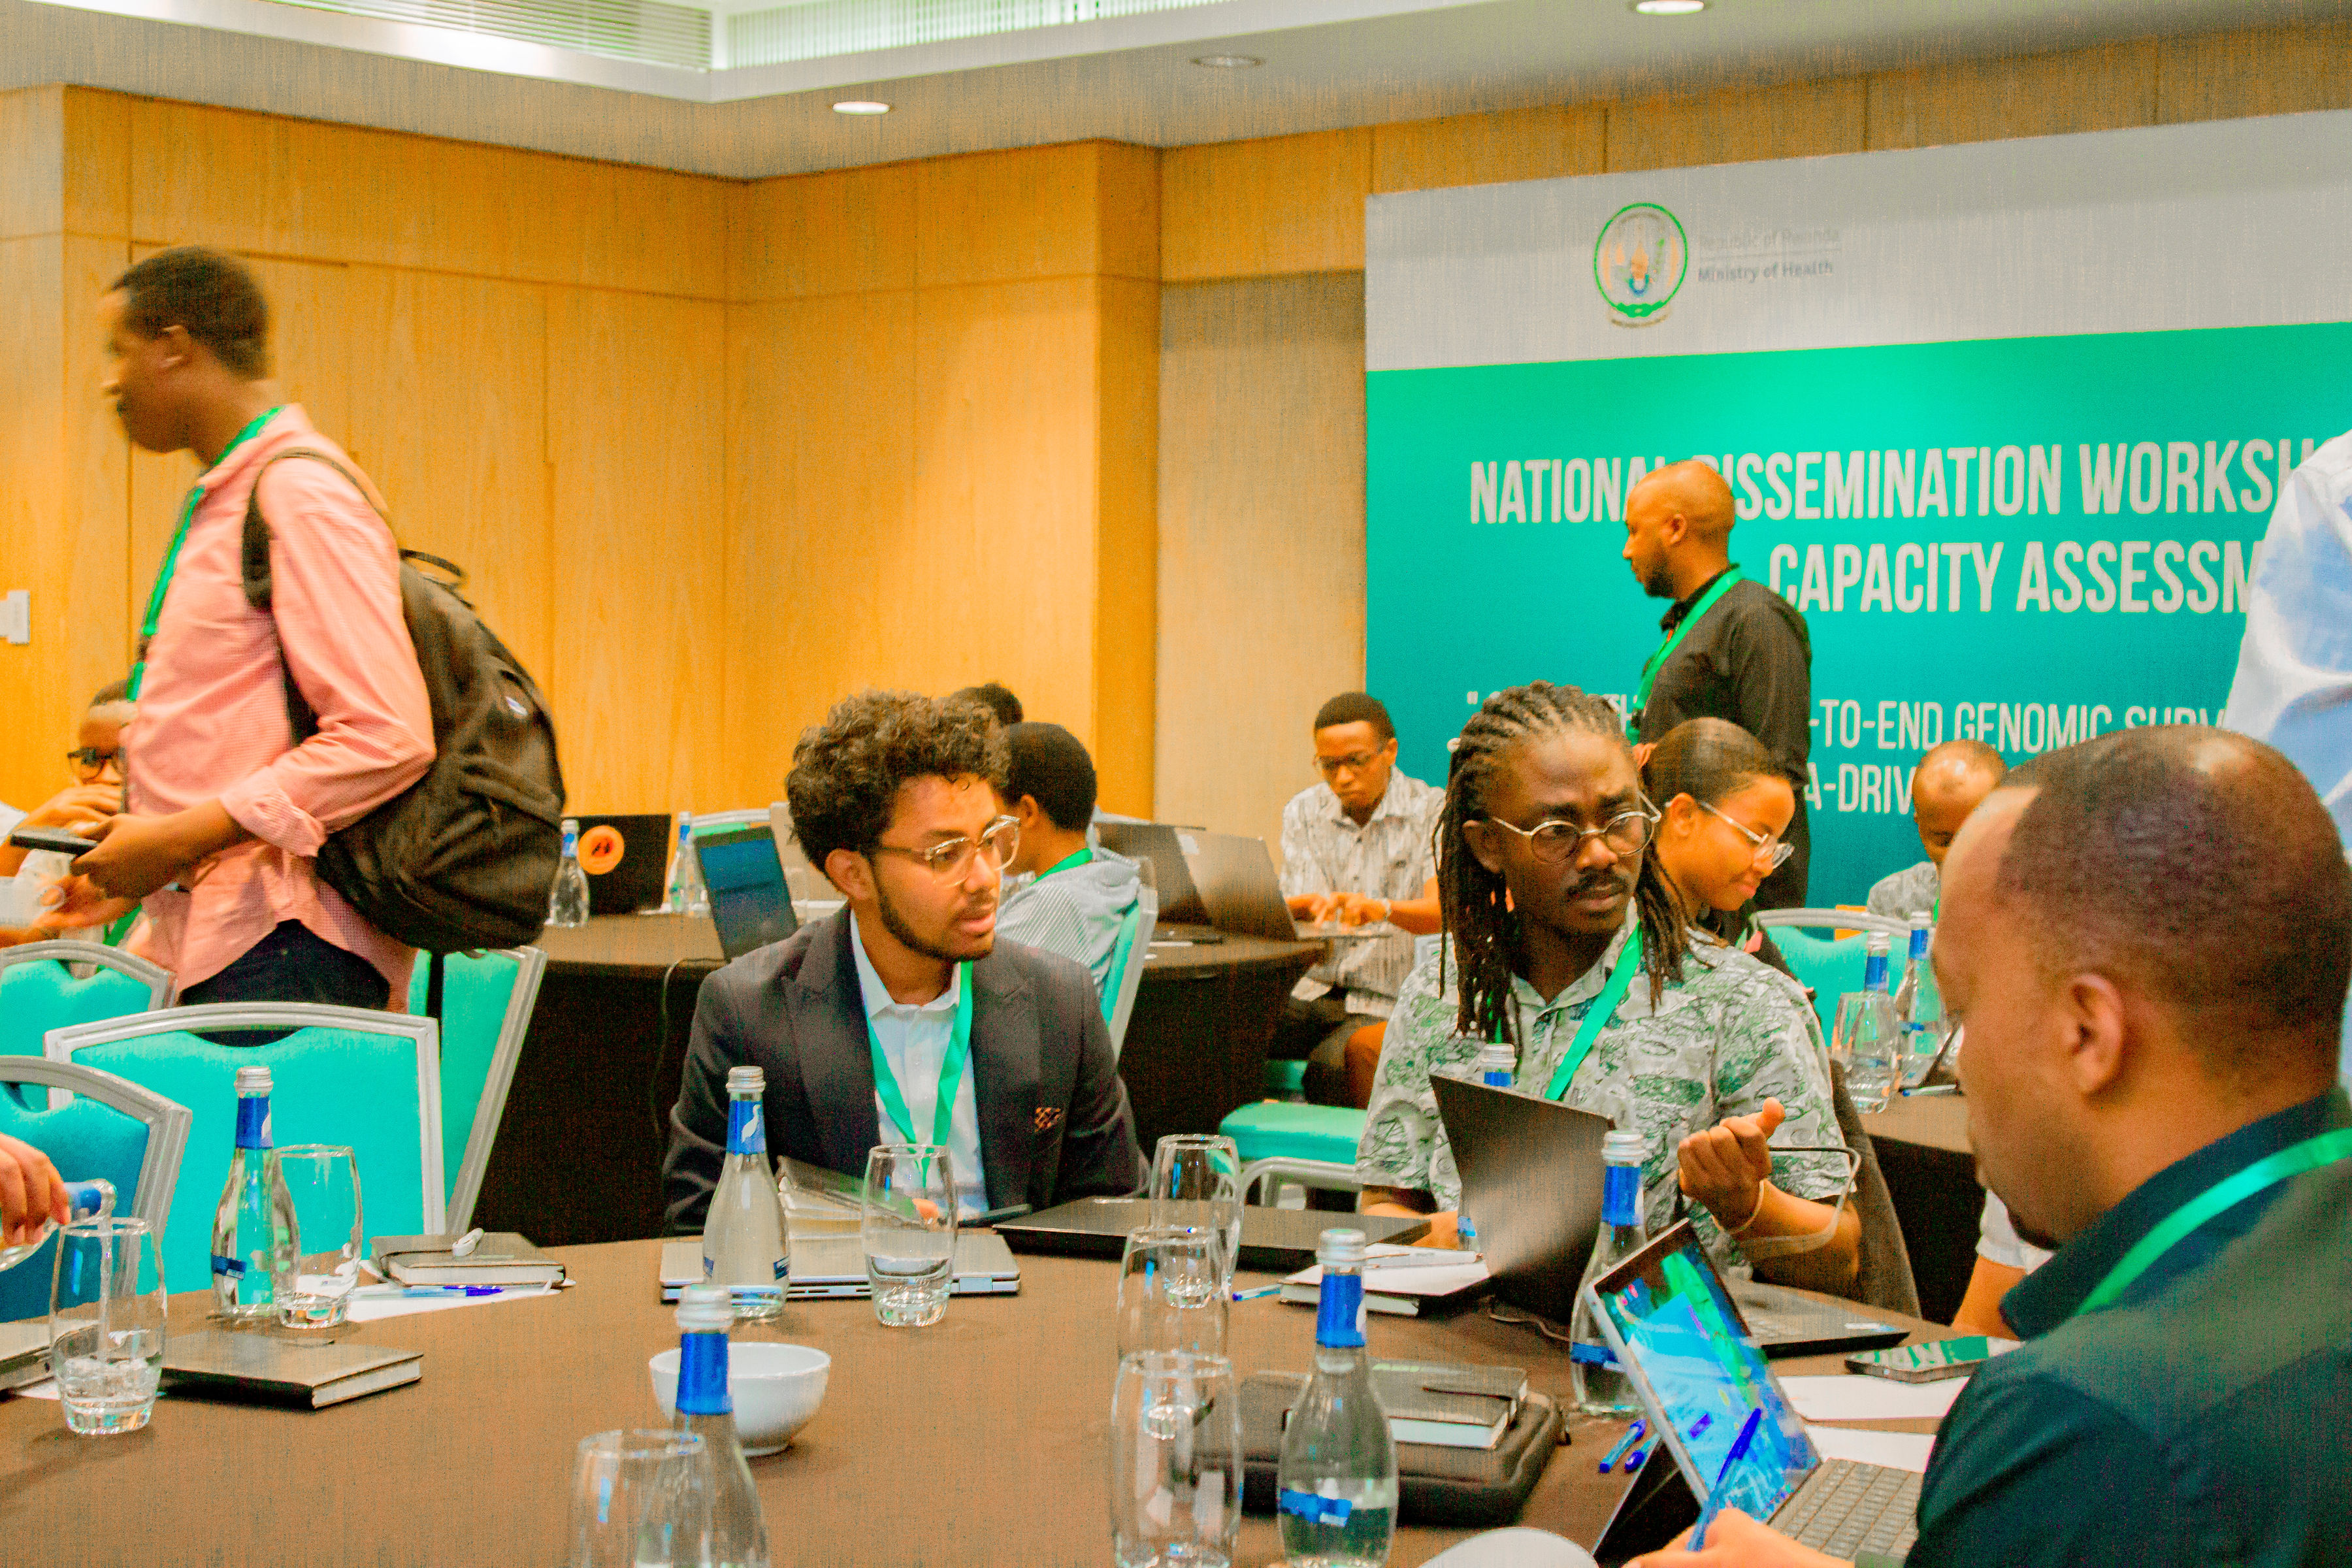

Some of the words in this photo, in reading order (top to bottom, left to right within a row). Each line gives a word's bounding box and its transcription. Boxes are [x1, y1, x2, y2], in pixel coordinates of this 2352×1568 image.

[1698, 265, 1759, 284] Ministry
[1763, 262, 1778, 278] of
[1782, 260, 1834, 278] Health
[1470, 456, 1665, 524] NATION
[1692, 444, 2062, 521] SSEMINATION
[1769, 542, 2004, 613] CAPACITY
[1954, 702, 2112, 753] GENOMIC
